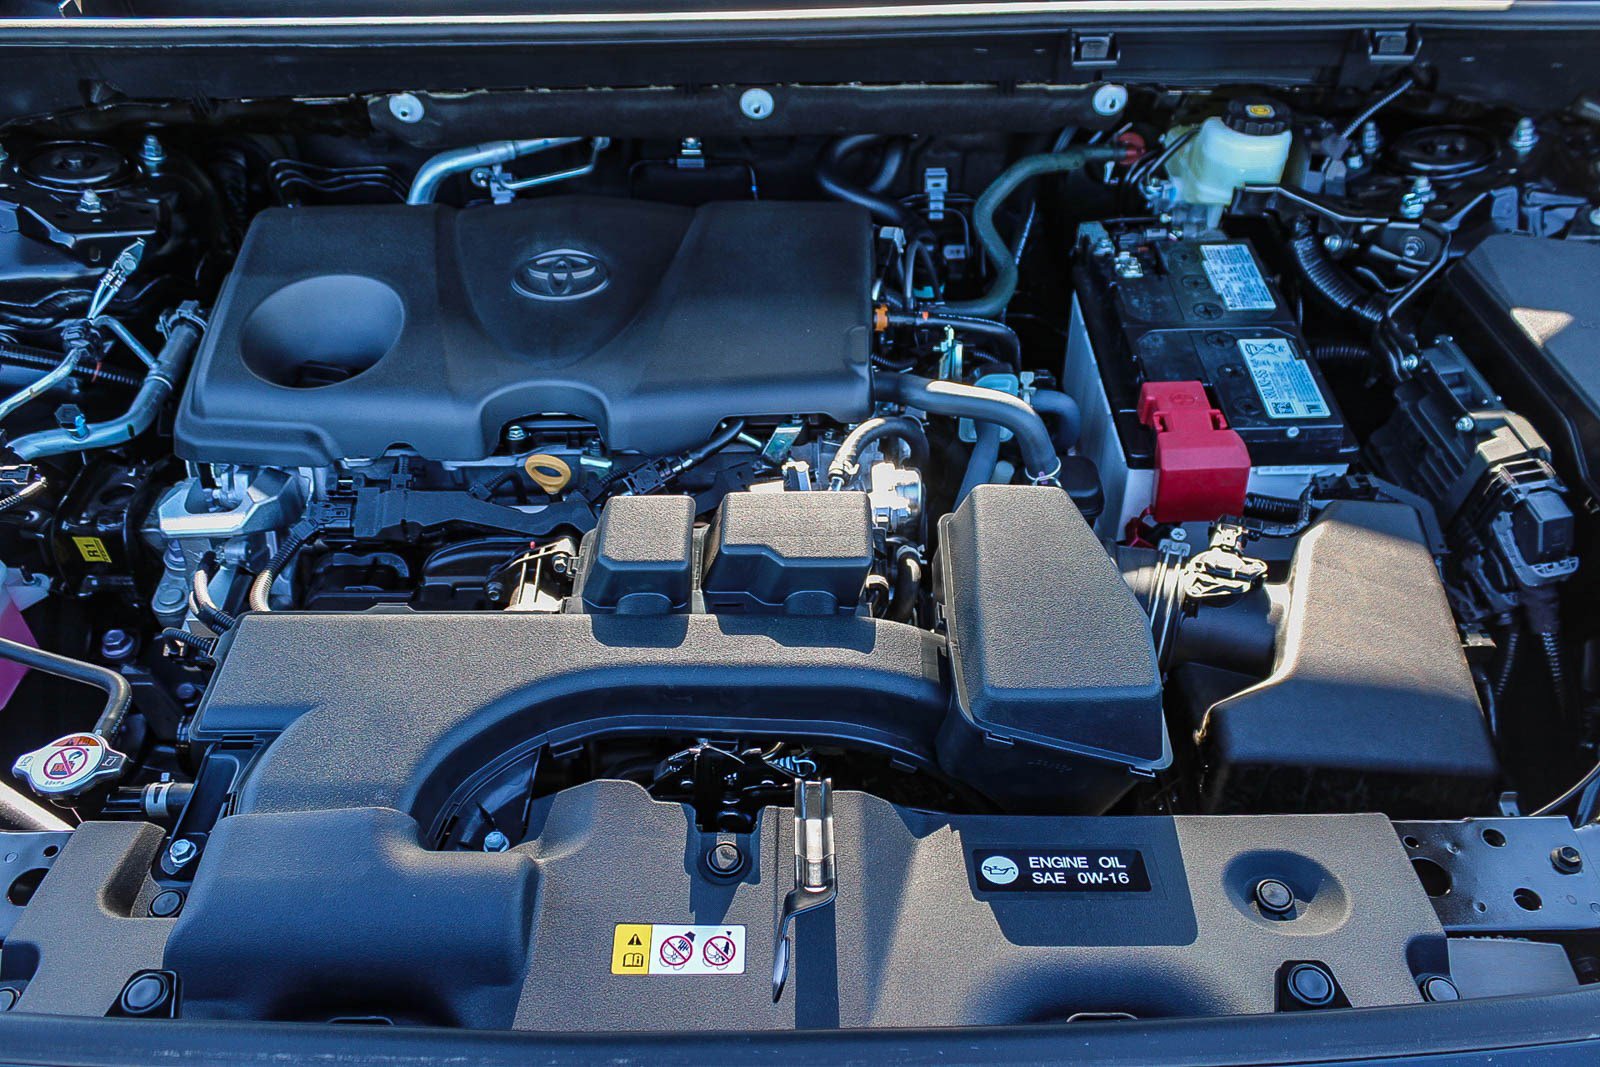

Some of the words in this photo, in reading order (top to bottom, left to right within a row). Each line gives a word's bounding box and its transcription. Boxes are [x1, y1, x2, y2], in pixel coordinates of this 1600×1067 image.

[83, 543, 100, 557] R1
[1028, 856, 1089, 869] ENGINE
[1098, 856, 1127, 869] OIL
[1032, 872, 1067, 884] SAE
[1077, 872, 1130, 884] 0W-16
